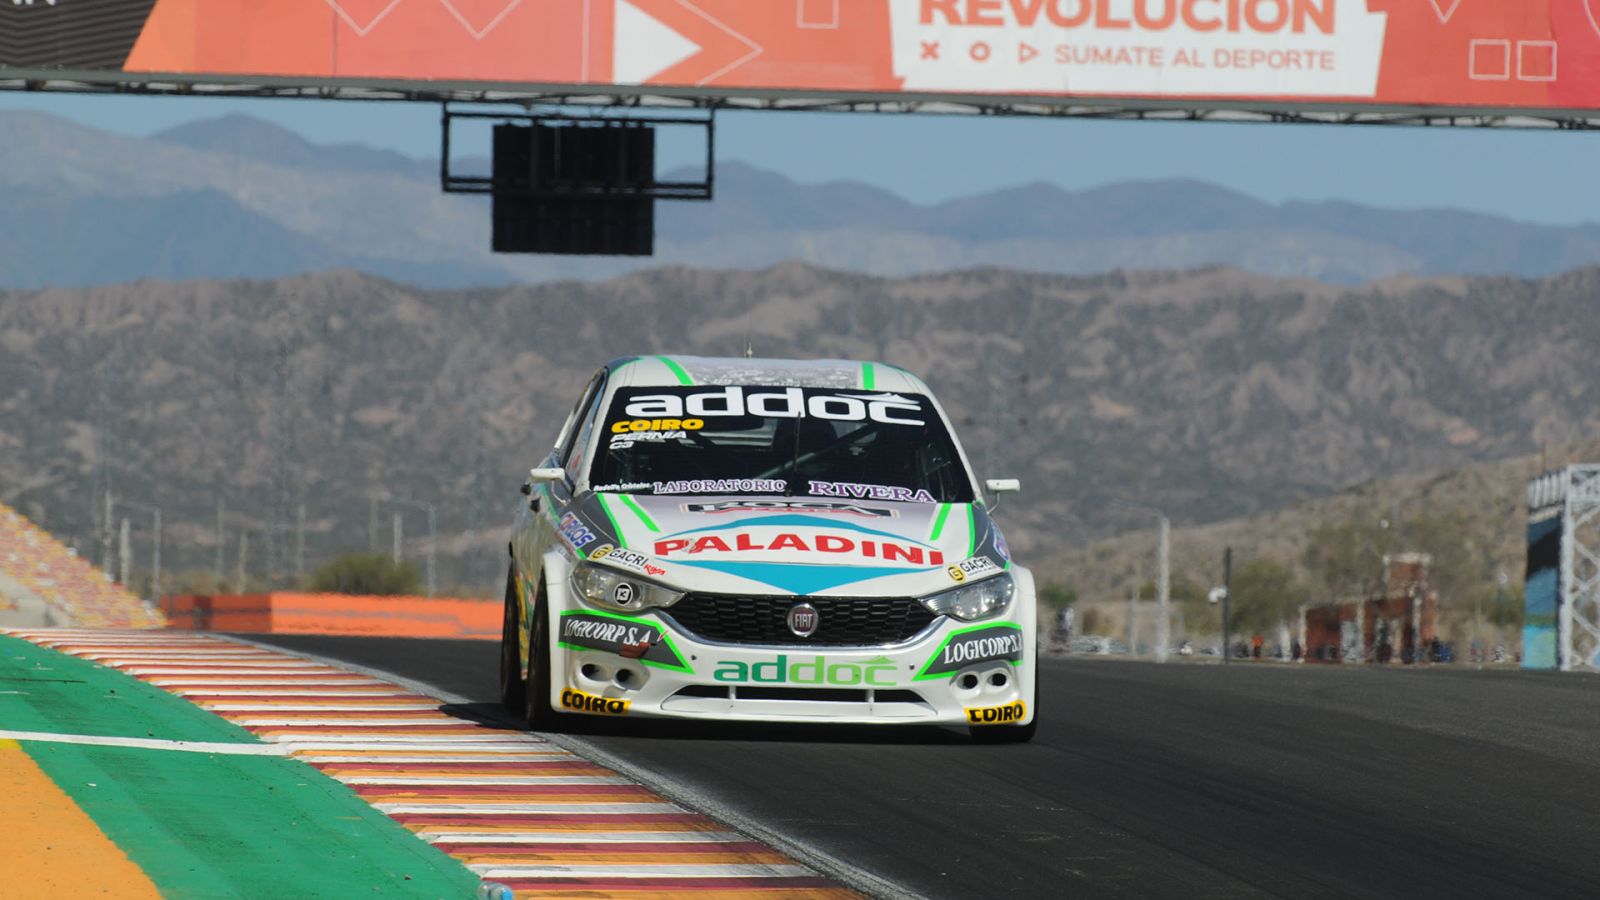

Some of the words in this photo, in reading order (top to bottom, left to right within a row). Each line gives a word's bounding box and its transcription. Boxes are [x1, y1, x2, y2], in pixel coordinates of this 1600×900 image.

[1055, 44, 1164, 67] SUMATE
[1172, 48, 1205, 68] AL
[1215, 48, 1336, 71] DEPORTE
[625, 386, 926, 427] addoc
[610, 431, 687, 443] PERNIA
[611, 418, 705, 433] COIRO
[653, 478, 787, 495] LABORATORIO
[809, 480, 937, 503] RIVERA
[609, 550, 649, 567] GACRI
[654, 533, 944, 566] PALADINI
[564, 619, 626, 643] LOGICORP
[794, 613, 813, 628] FIAT
[944, 636, 1011, 664] LOGICORP
[714, 655, 897, 686] addoc
[562, 690, 625, 714] COIRO
[969, 704, 1023, 722] COIRO
